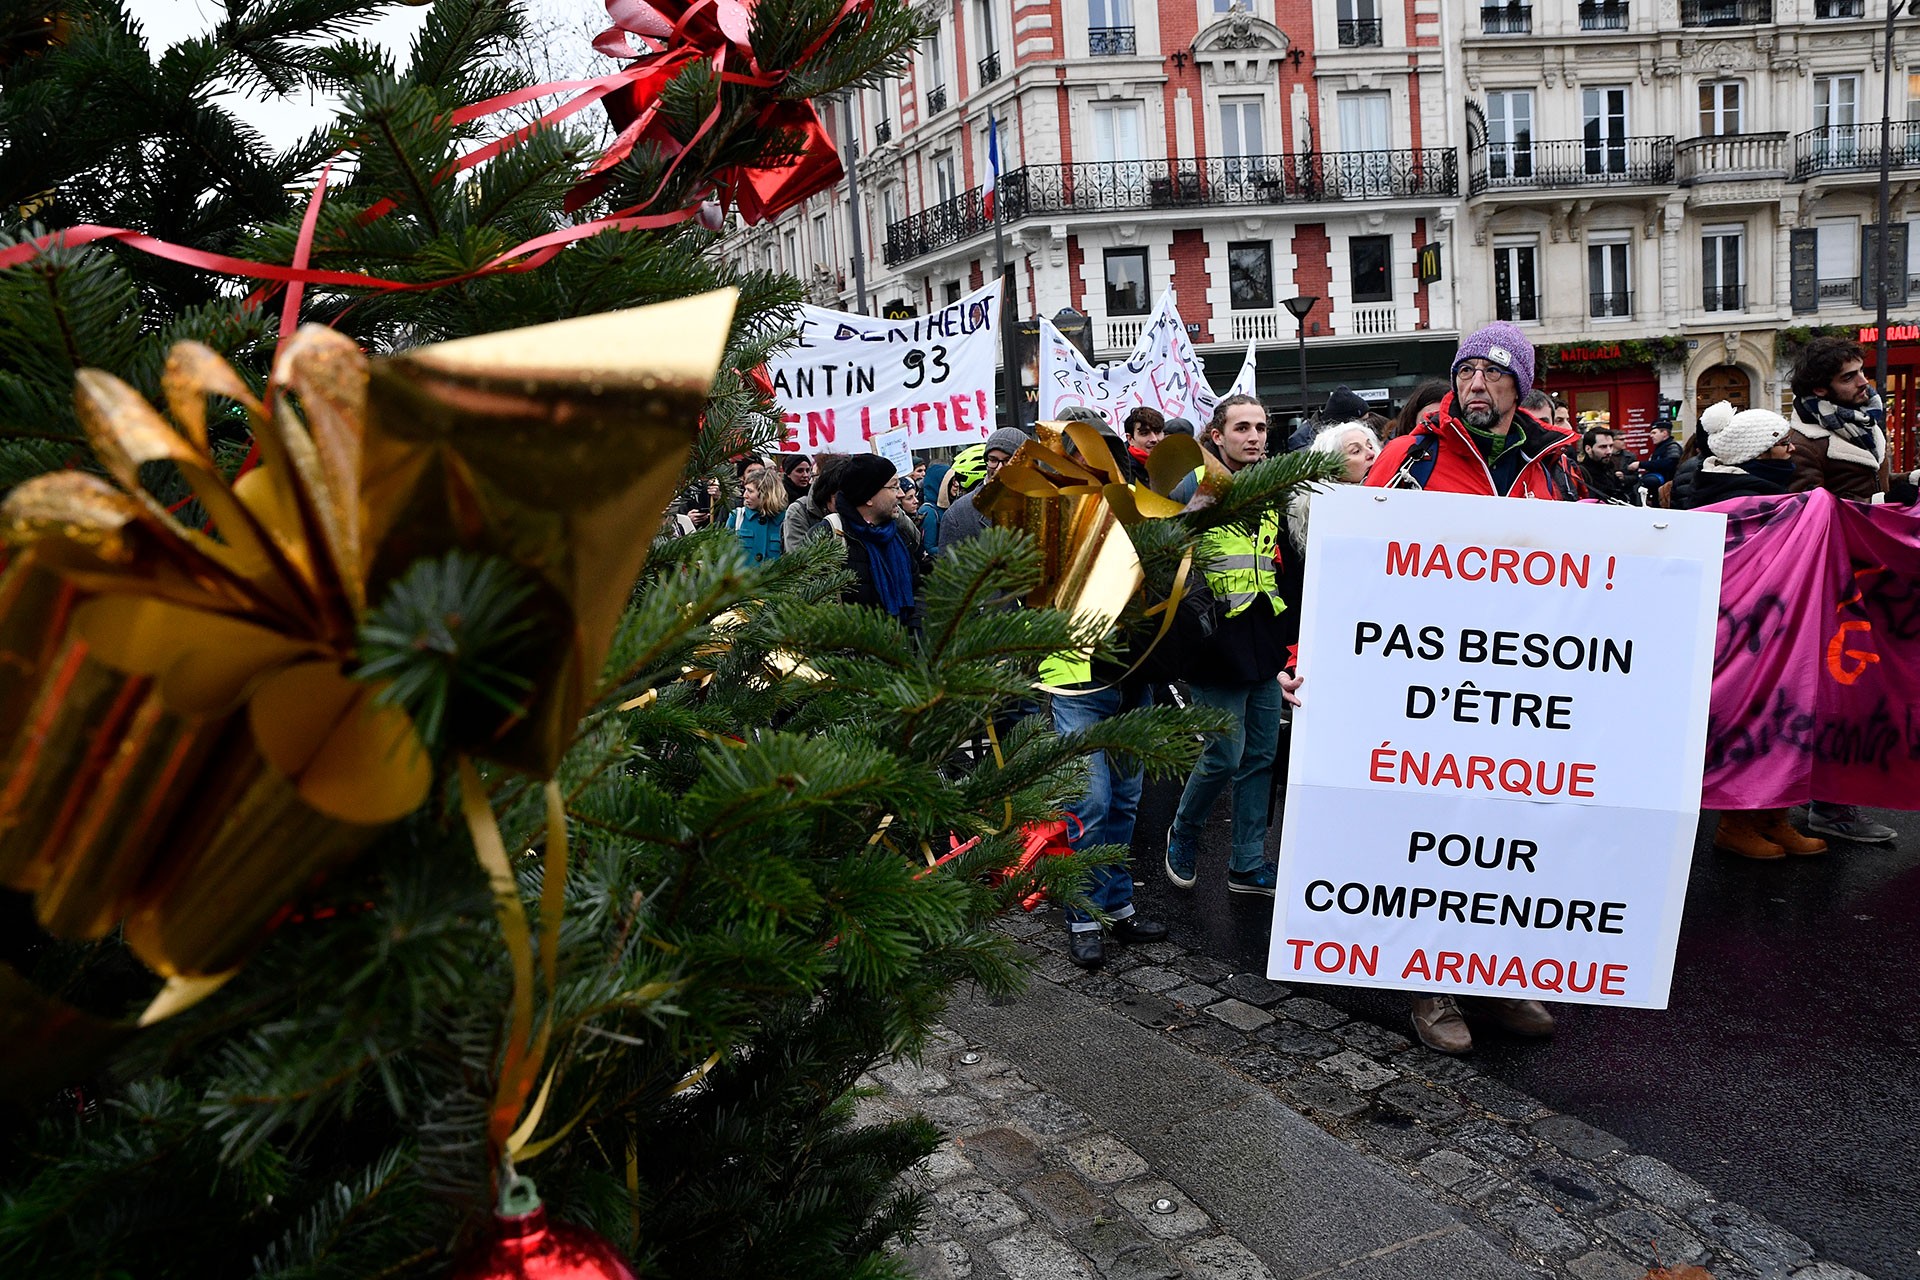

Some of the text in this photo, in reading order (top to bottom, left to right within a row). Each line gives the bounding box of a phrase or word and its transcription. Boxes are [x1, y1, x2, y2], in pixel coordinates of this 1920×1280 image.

[1859, 326, 1920, 343] NATRALIA
[903, 345, 950, 389] 93
[778, 407, 836, 453] EN
[1386, 541, 1616, 591] MACRON !
[1355, 621, 1633, 674] PAS BESOIN
[1405, 681, 1573, 730] D’ÊTRE
[1369, 741, 1596, 797] ÉNARQUE
[1408, 831, 1538, 873] POUR
[1304, 880, 1627, 934] COMPRENDRE
[1286, 939, 1628, 996] TON ARNAQUE
